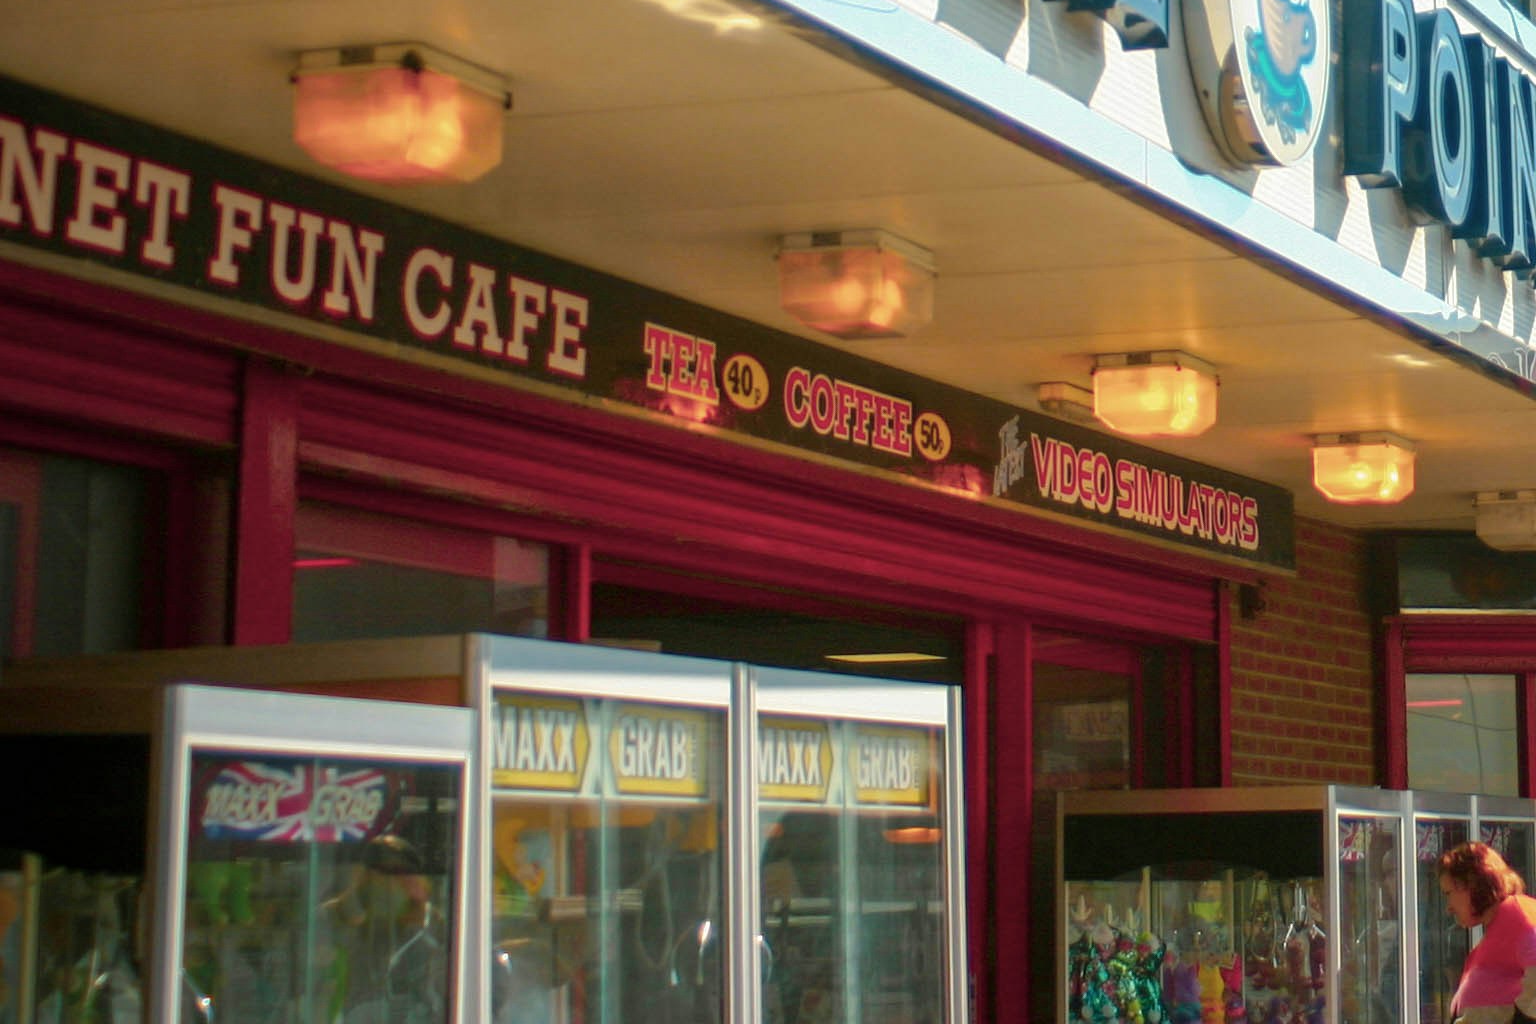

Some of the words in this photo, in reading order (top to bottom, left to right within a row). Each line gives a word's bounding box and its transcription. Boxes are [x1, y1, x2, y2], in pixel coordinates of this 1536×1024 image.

[209, 185, 385, 321] FUN
[403, 247, 590, 377] CAFE
[644, 322, 720, 406] TEA
[784, 366, 913, 458] COFFEE
[1030, 432, 1114, 514] VIDEO
[1115, 459, 1259, 551] SIMULATORS
[491, 704, 577, 773] MAXX
[618, 714, 688, 780] GRAB
[757, 727, 823, 785] MAXX
[856, 736, 911, 790] GRAB
